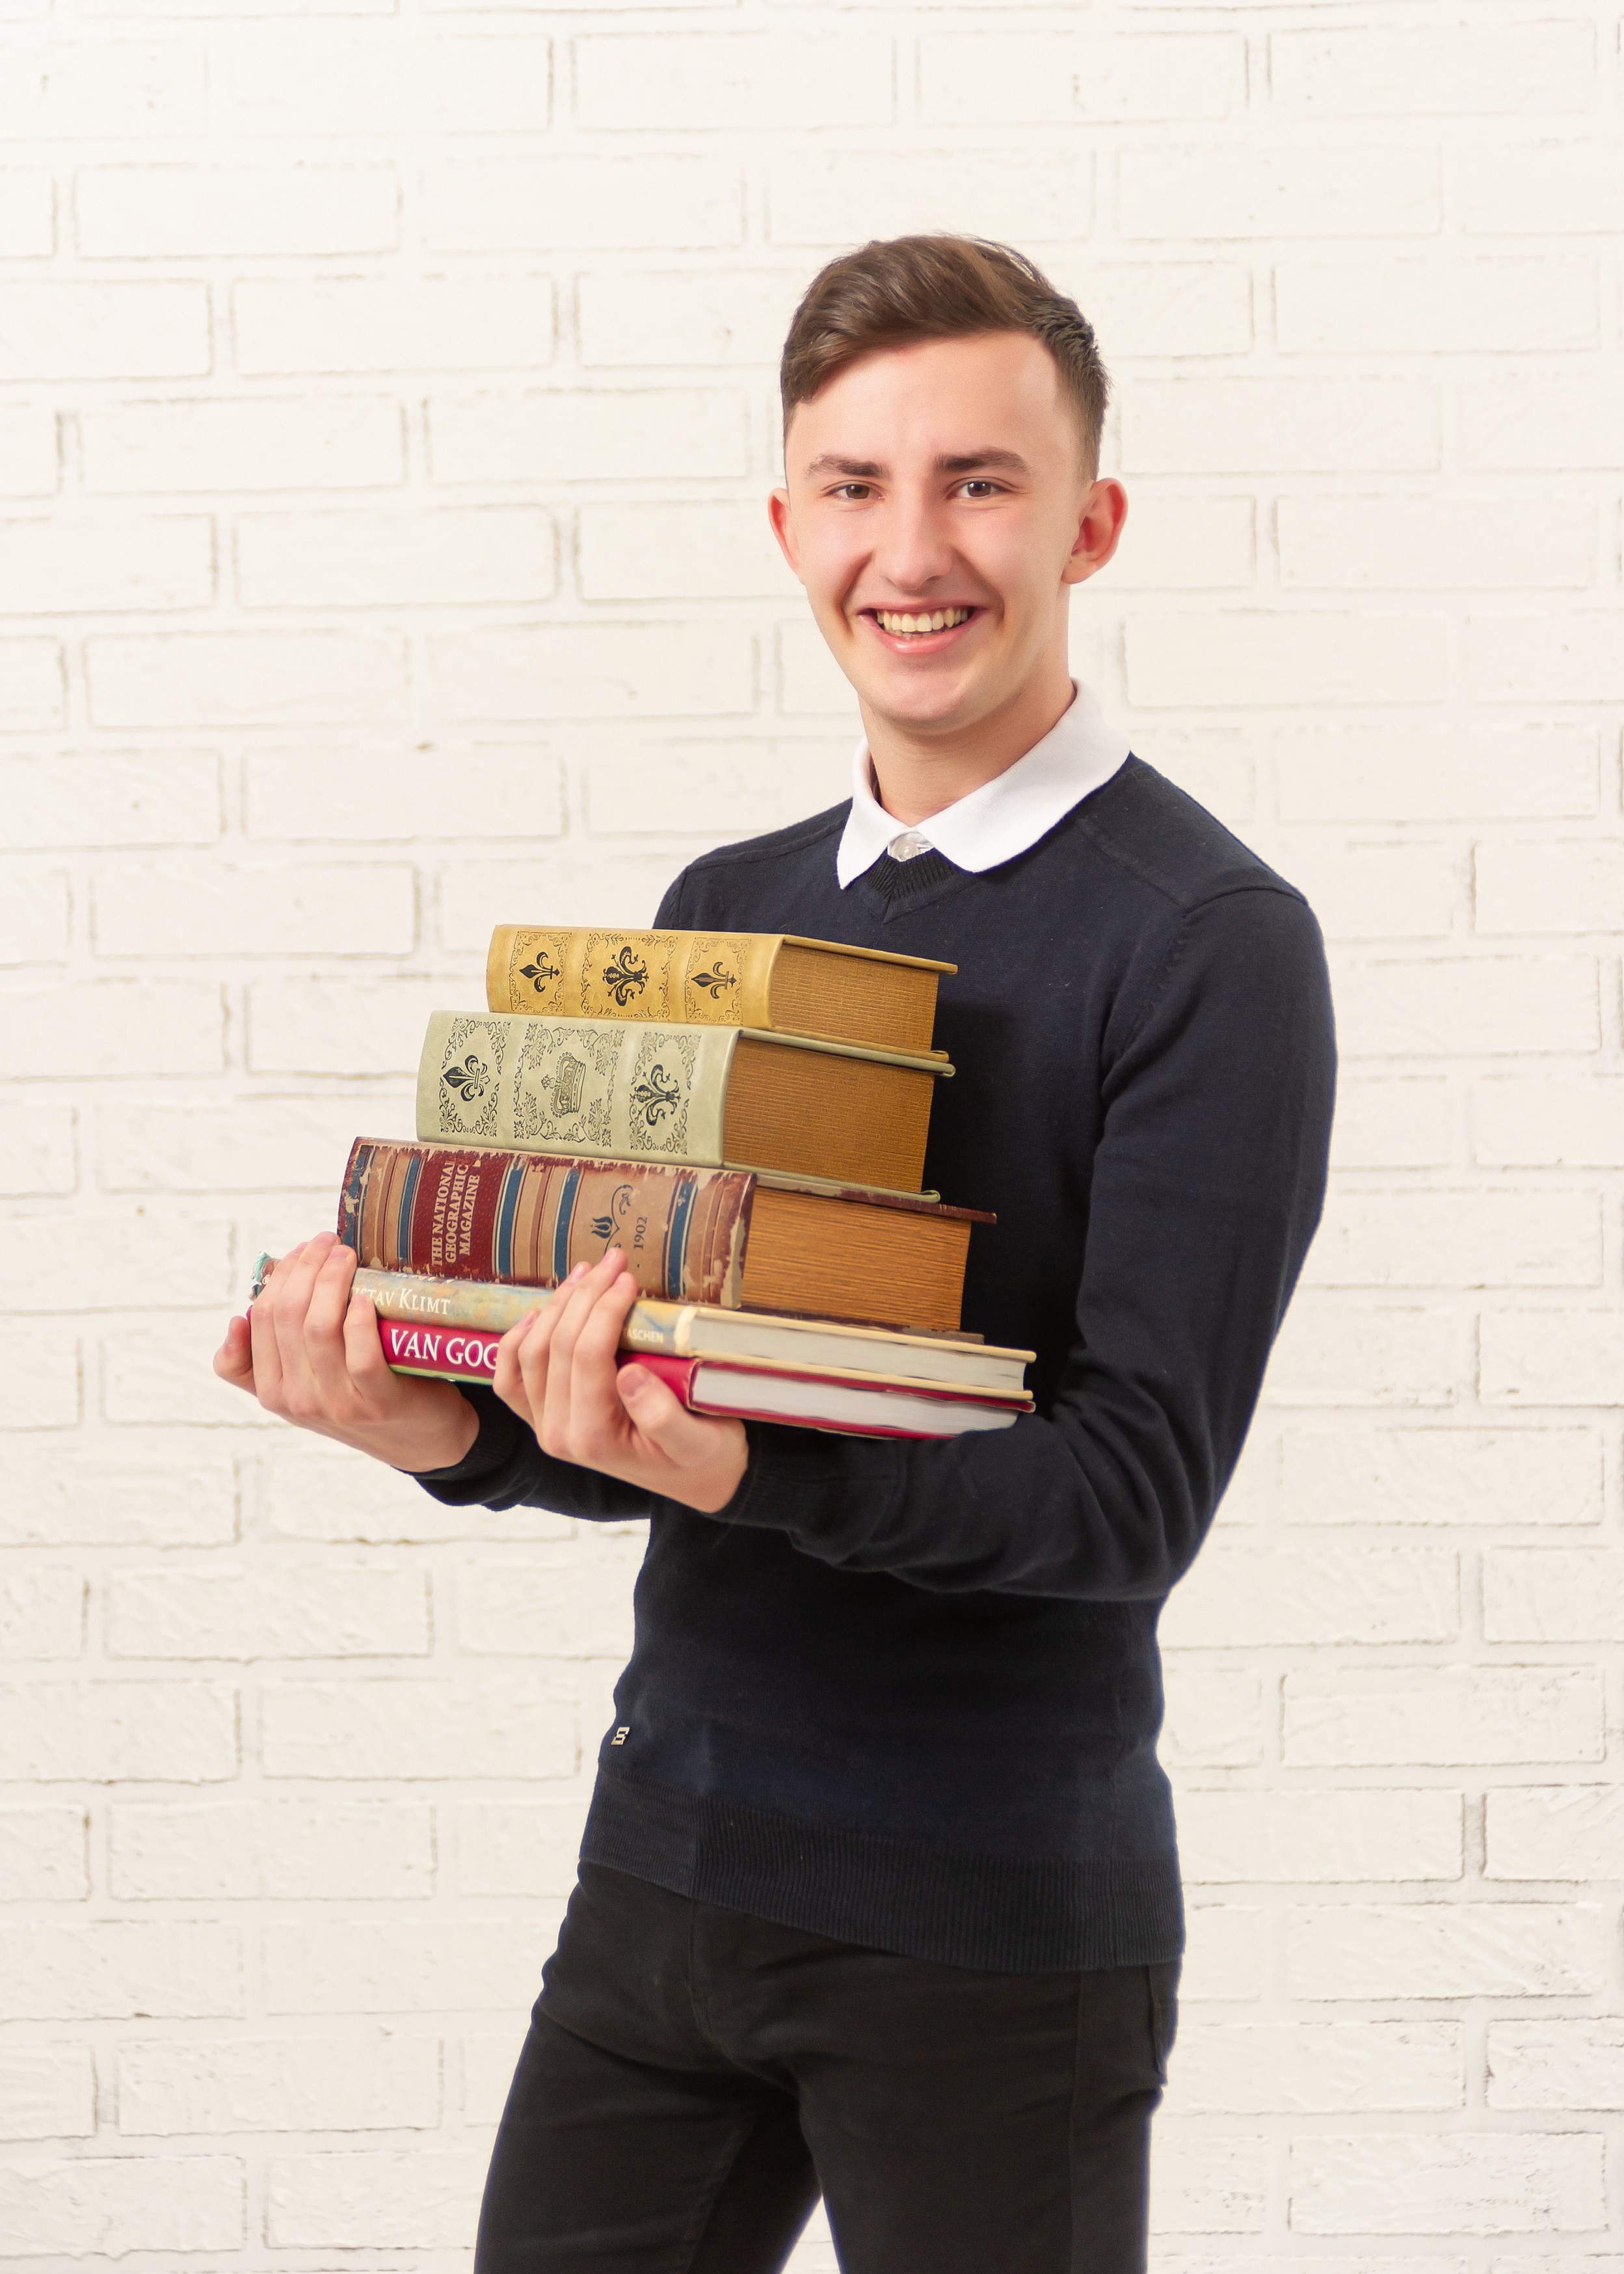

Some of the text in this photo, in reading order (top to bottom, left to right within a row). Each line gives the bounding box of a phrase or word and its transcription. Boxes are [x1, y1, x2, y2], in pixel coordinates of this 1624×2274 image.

[446, 1164, 469, 1263] GEOGRAPHIC
[459, 1174, 480, 1256] MAGAZINE
[633, 1216, 648, 1250] 1902
[432, 1237, 443, 1266] THE
[399, 1288, 451, 1315] KLIMT
[391, 1328, 499, 1370] VAN GOG
[627, 1328, 664, 1343] ASCHEN
